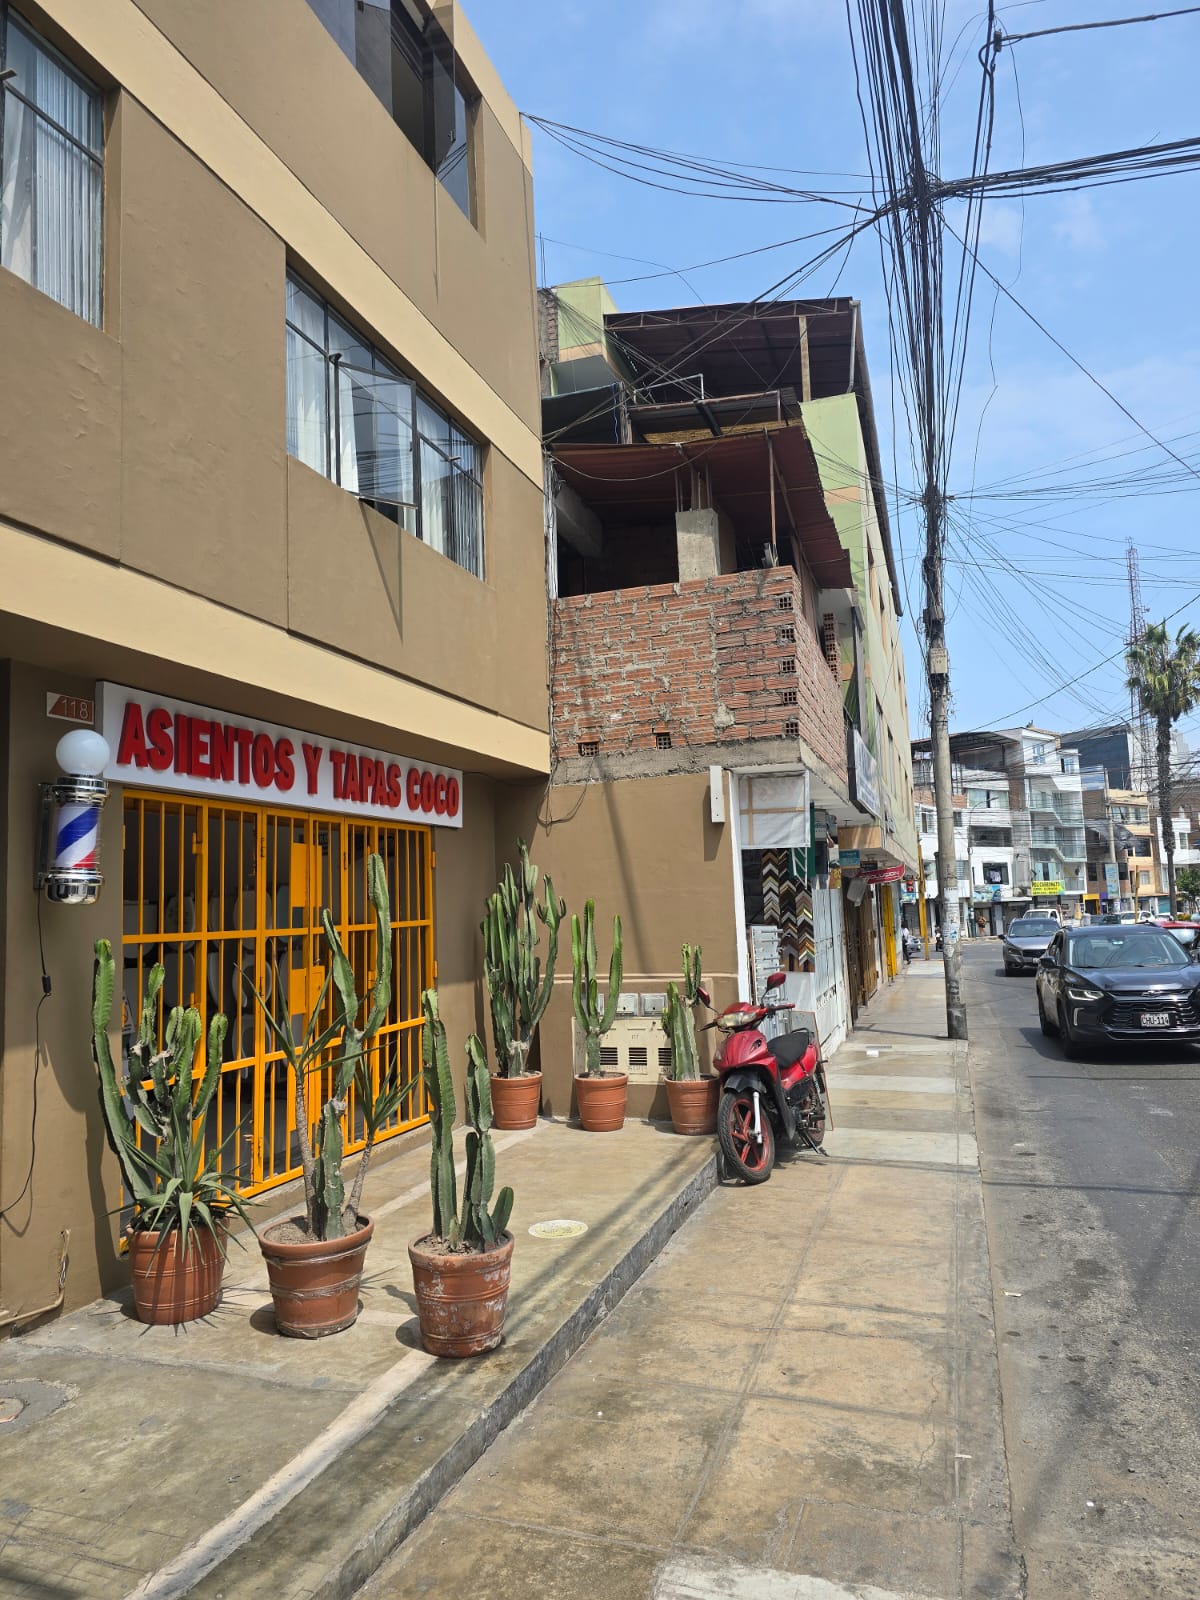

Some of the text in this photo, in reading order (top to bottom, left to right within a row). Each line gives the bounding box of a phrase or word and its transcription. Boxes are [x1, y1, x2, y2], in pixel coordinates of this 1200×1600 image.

[61, 698, 88, 720] 118
[117, 702, 460, 817] ASIENTOS Y TAPAS COCO
